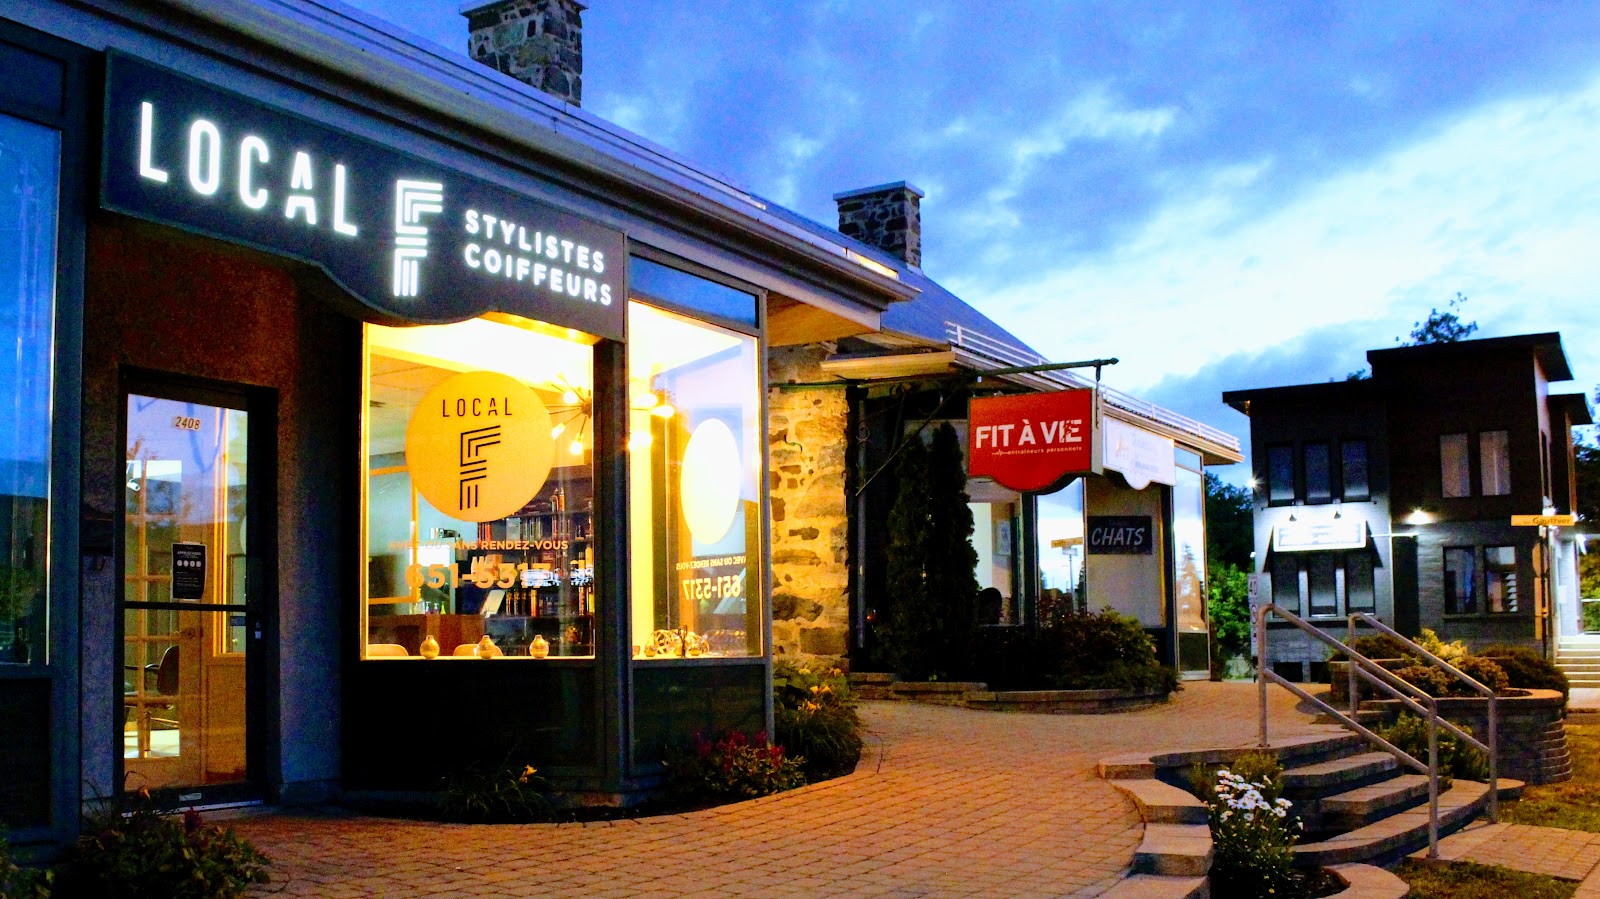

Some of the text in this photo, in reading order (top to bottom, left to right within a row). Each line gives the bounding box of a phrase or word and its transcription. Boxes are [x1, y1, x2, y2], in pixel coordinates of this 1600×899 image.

[139, 101, 358, 237] LOCAL
[464, 208, 605, 273] STYLISTES
[463, 243, 612, 306] COIFFEURS
[442, 397, 513, 418] LOCAL
[175, 416, 200, 430] 2408
[975, 418, 1083, 449] FIT À VIE
[1532, 516, 1570, 526] Gauthier
[447, 541, 478, 550] SANS
[481, 540, 569, 550] RENDEZ-VOUS
[1091, 527, 1145, 546] CHATS
[405, 562, 551, 589] 651-5317
